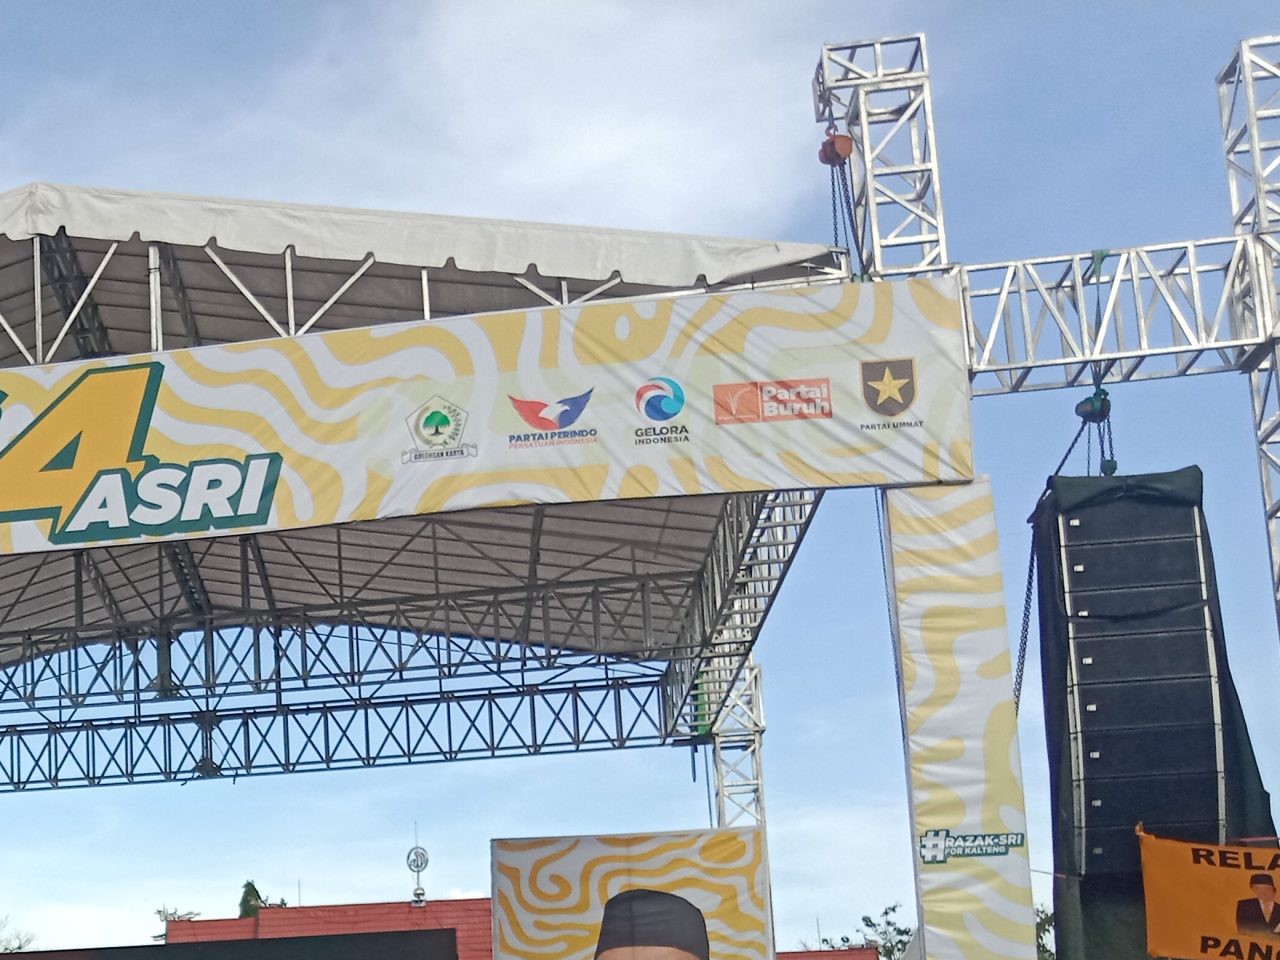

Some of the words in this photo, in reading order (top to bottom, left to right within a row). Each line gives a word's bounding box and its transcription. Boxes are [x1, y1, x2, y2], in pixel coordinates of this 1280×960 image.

[763, 383, 828, 401] Partai
[763, 399, 831, 417] Buruh
[634, 425, 689, 438] GELORA
[860, 422, 891, 431] PARTAI
[892, 420, 924, 429] UMMAT
[508, 432, 549, 443] PARTAI
[550, 428, 598, 440] PERINDO
[634, 435, 690, 446] INDONESIA
[63, 457, 271, 534] ASRI
[920, 830, 1022, 862] #RAZAK-SRI
[945, 846, 963, 856] FOR
[964, 844, 1006, 855] KALTENG
